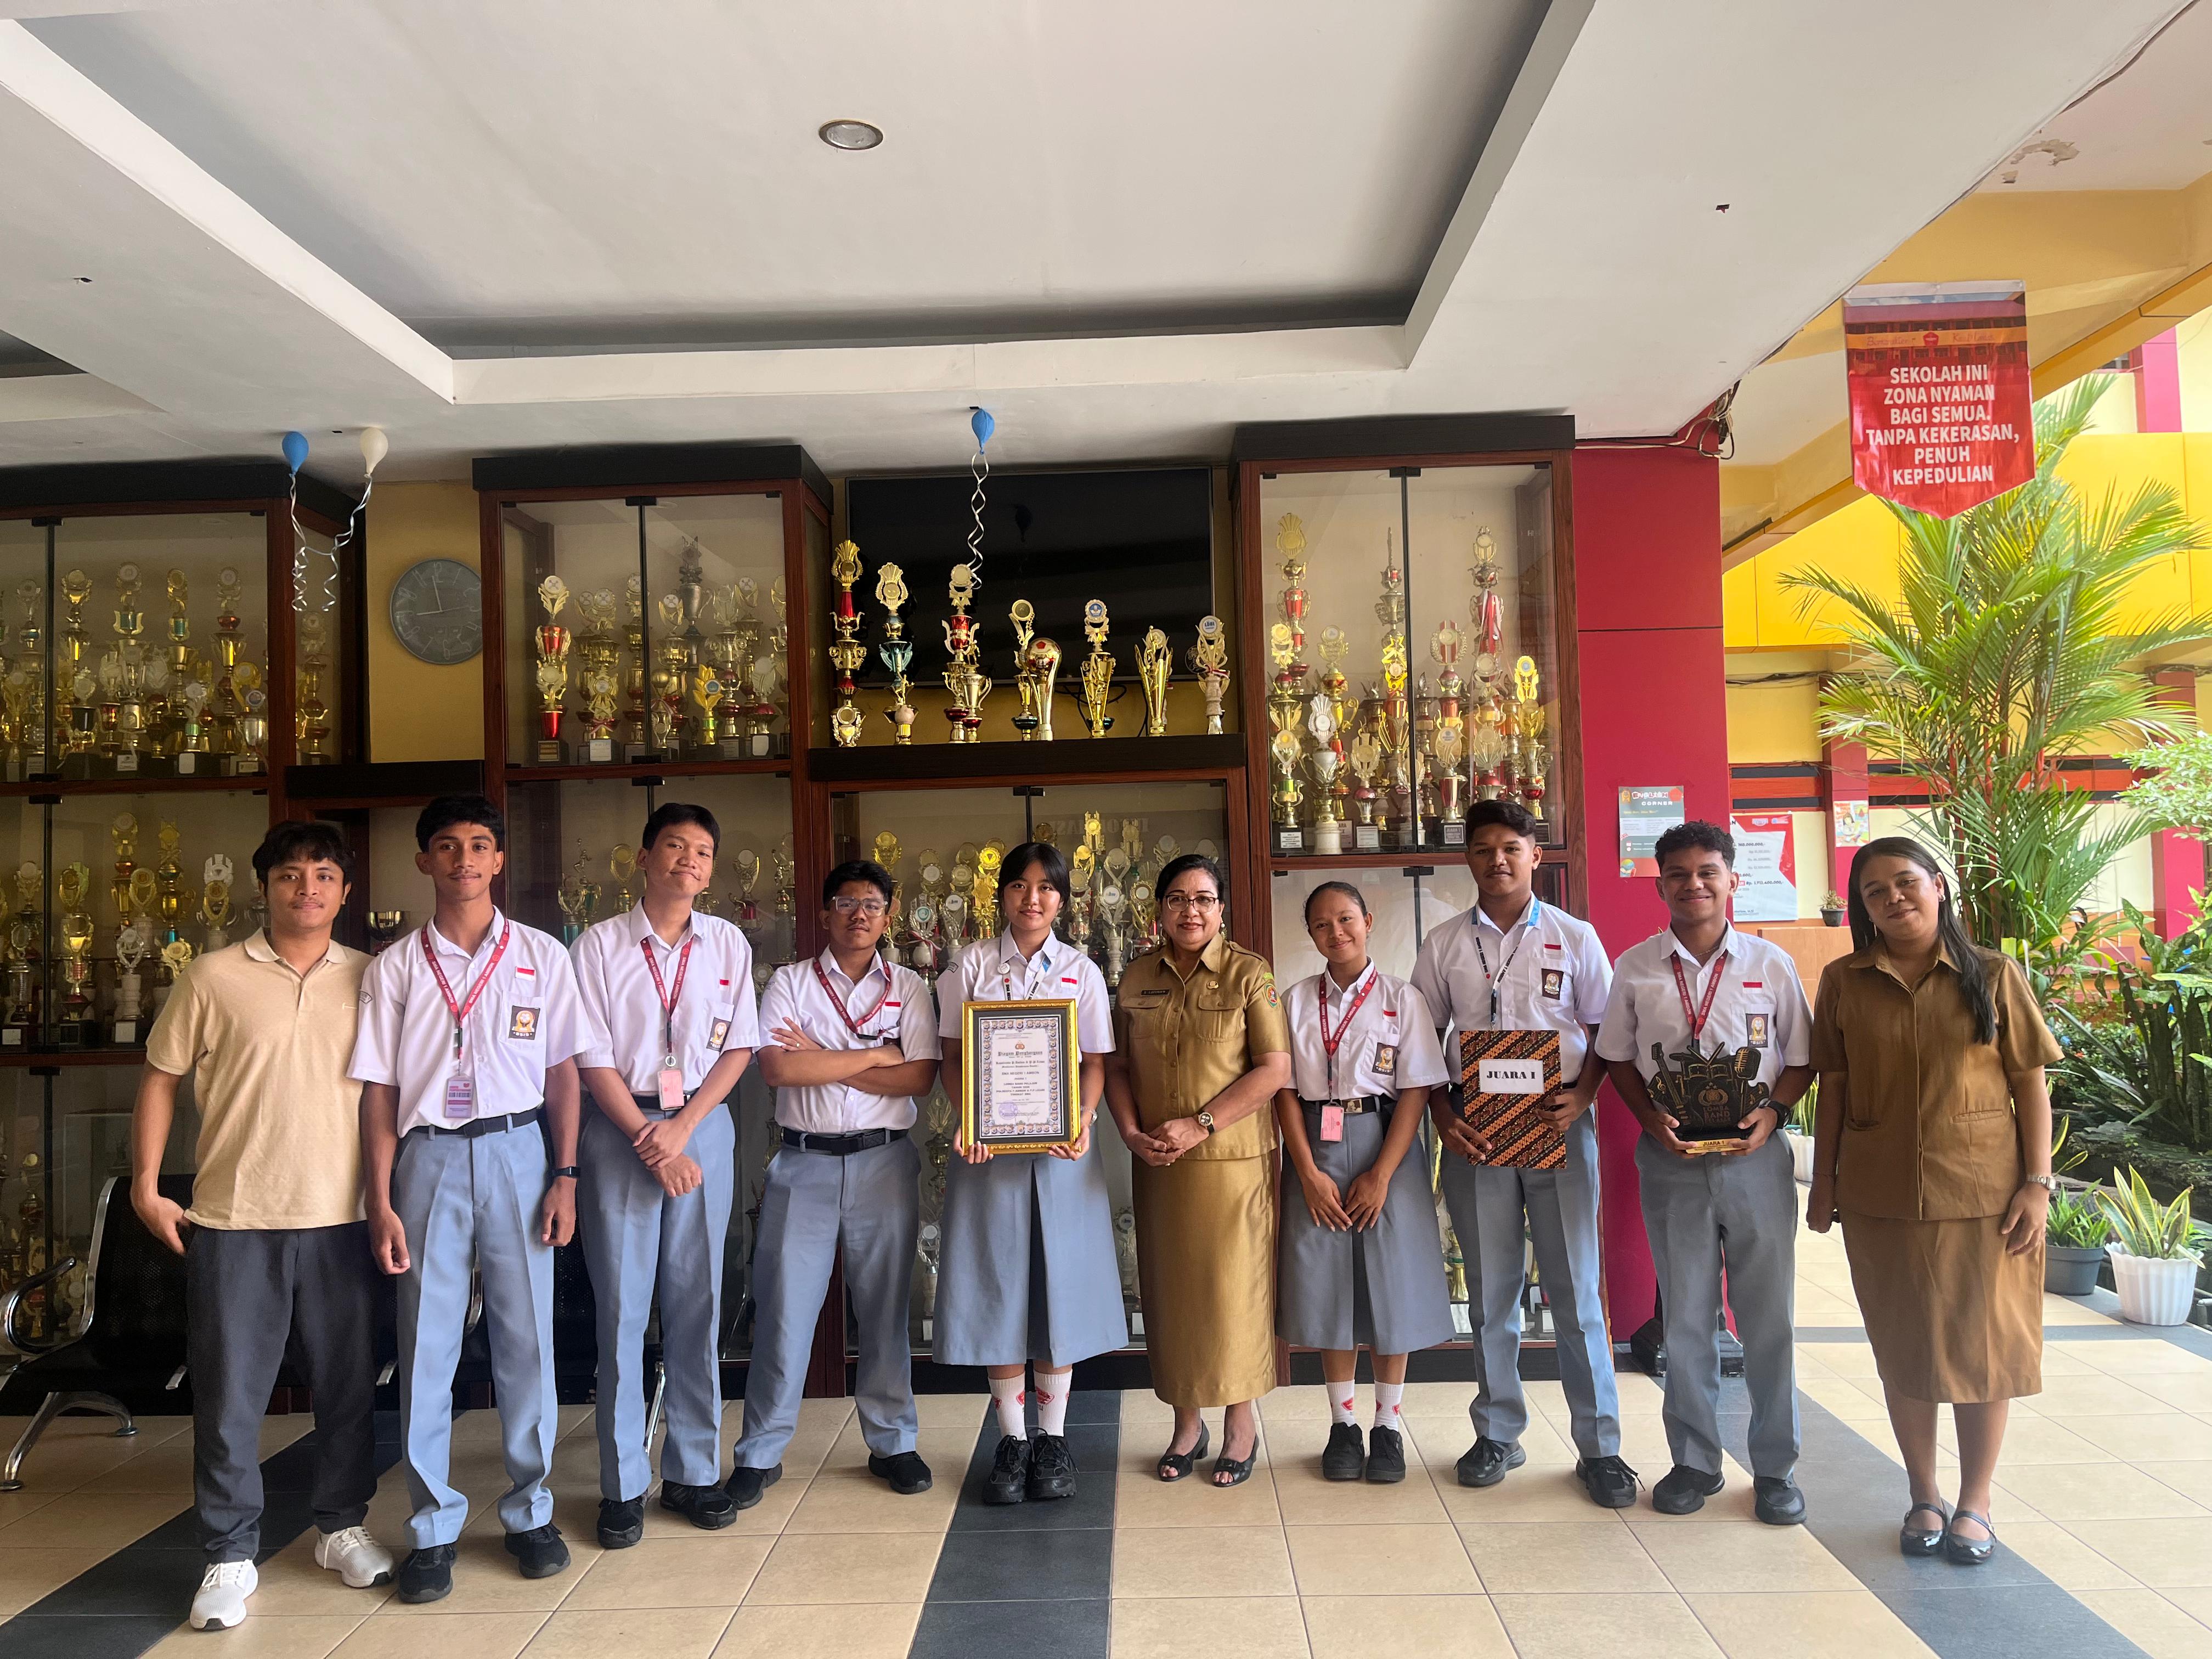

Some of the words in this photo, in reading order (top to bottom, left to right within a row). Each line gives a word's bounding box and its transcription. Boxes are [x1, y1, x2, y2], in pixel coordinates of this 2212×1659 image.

[1890, 365, 1962, 384] SEKOLAH
[1966, 364, 1988, 381] INI
[1884, 388, 1927, 405] ZONA
[1931, 385, 1995, 403] NYAMAN
[1891, 407, 1927, 425] BAGI
[1931, 405, 1991, 424] SEMUA.
[1865, 428, 1916, 446] TANPA
[1920, 424, 2019, 444] KEKERASAN,
[1914, 445, 1970, 465] PENUH
[1893, 465, 1993, 486] KEPEDULIAN
[1632, 791, 1668, 799] ENGLISH
[469, 994, 477, 1004] SMA
[473, 980, 484, 995] NEGERI
[485, 962, 495, 977] AMBON
[652, 966, 661, 981] NEGERI
[436, 969, 447, 985] NEGERI
[444, 988, 455, 1003] AMBON
[1339, 1020, 1347, 1033] NEGERI
[1347, 1006, 1356, 1018] AMBON
[1486, 1070, 1527, 1080] JUARA
[1531, 1071, 1536, 1080] I
